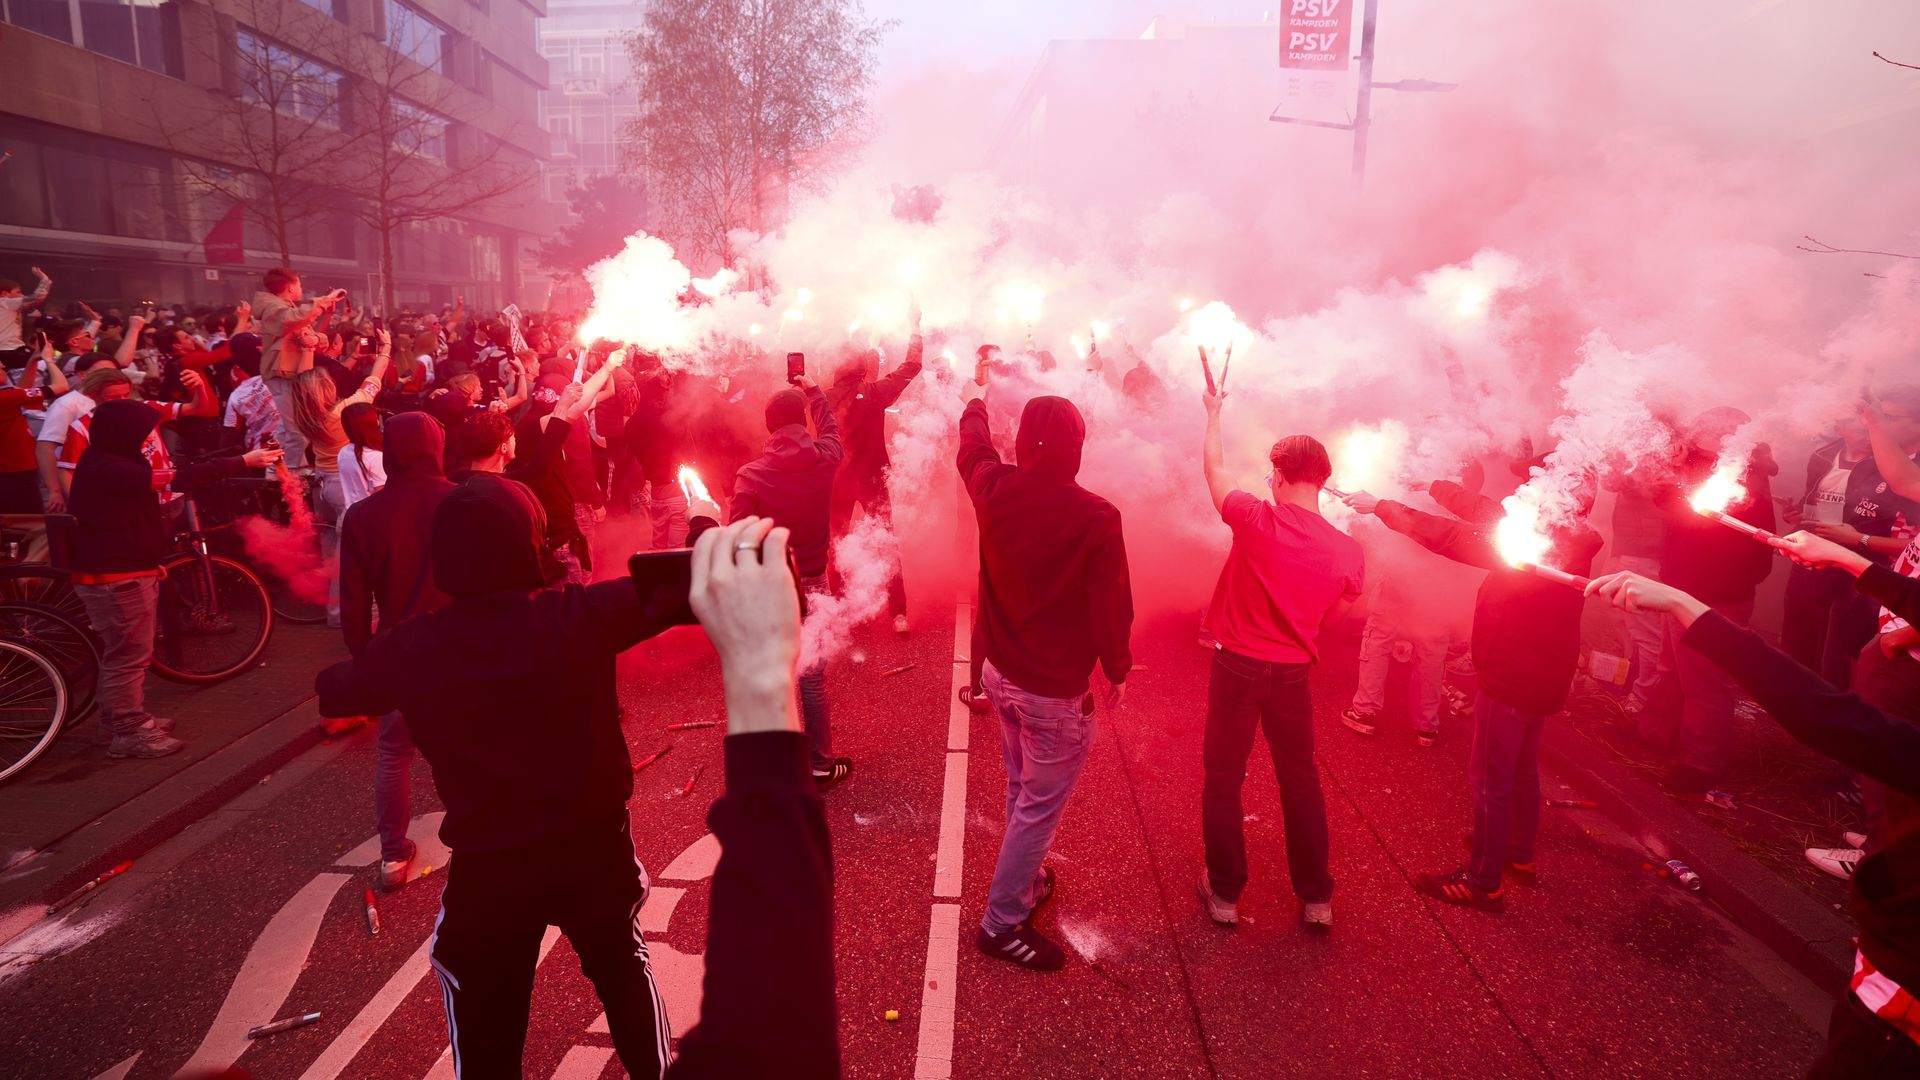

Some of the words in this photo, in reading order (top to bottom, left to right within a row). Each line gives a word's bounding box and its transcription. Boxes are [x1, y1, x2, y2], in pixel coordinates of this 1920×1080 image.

[1290, 0, 1340, 17] PSV
[1290, 18, 1338, 27] KAMPIOEN
[1289, 32, 1338, 51] PSV
[1289, 52, 1336, 61] KAMPIOEN
